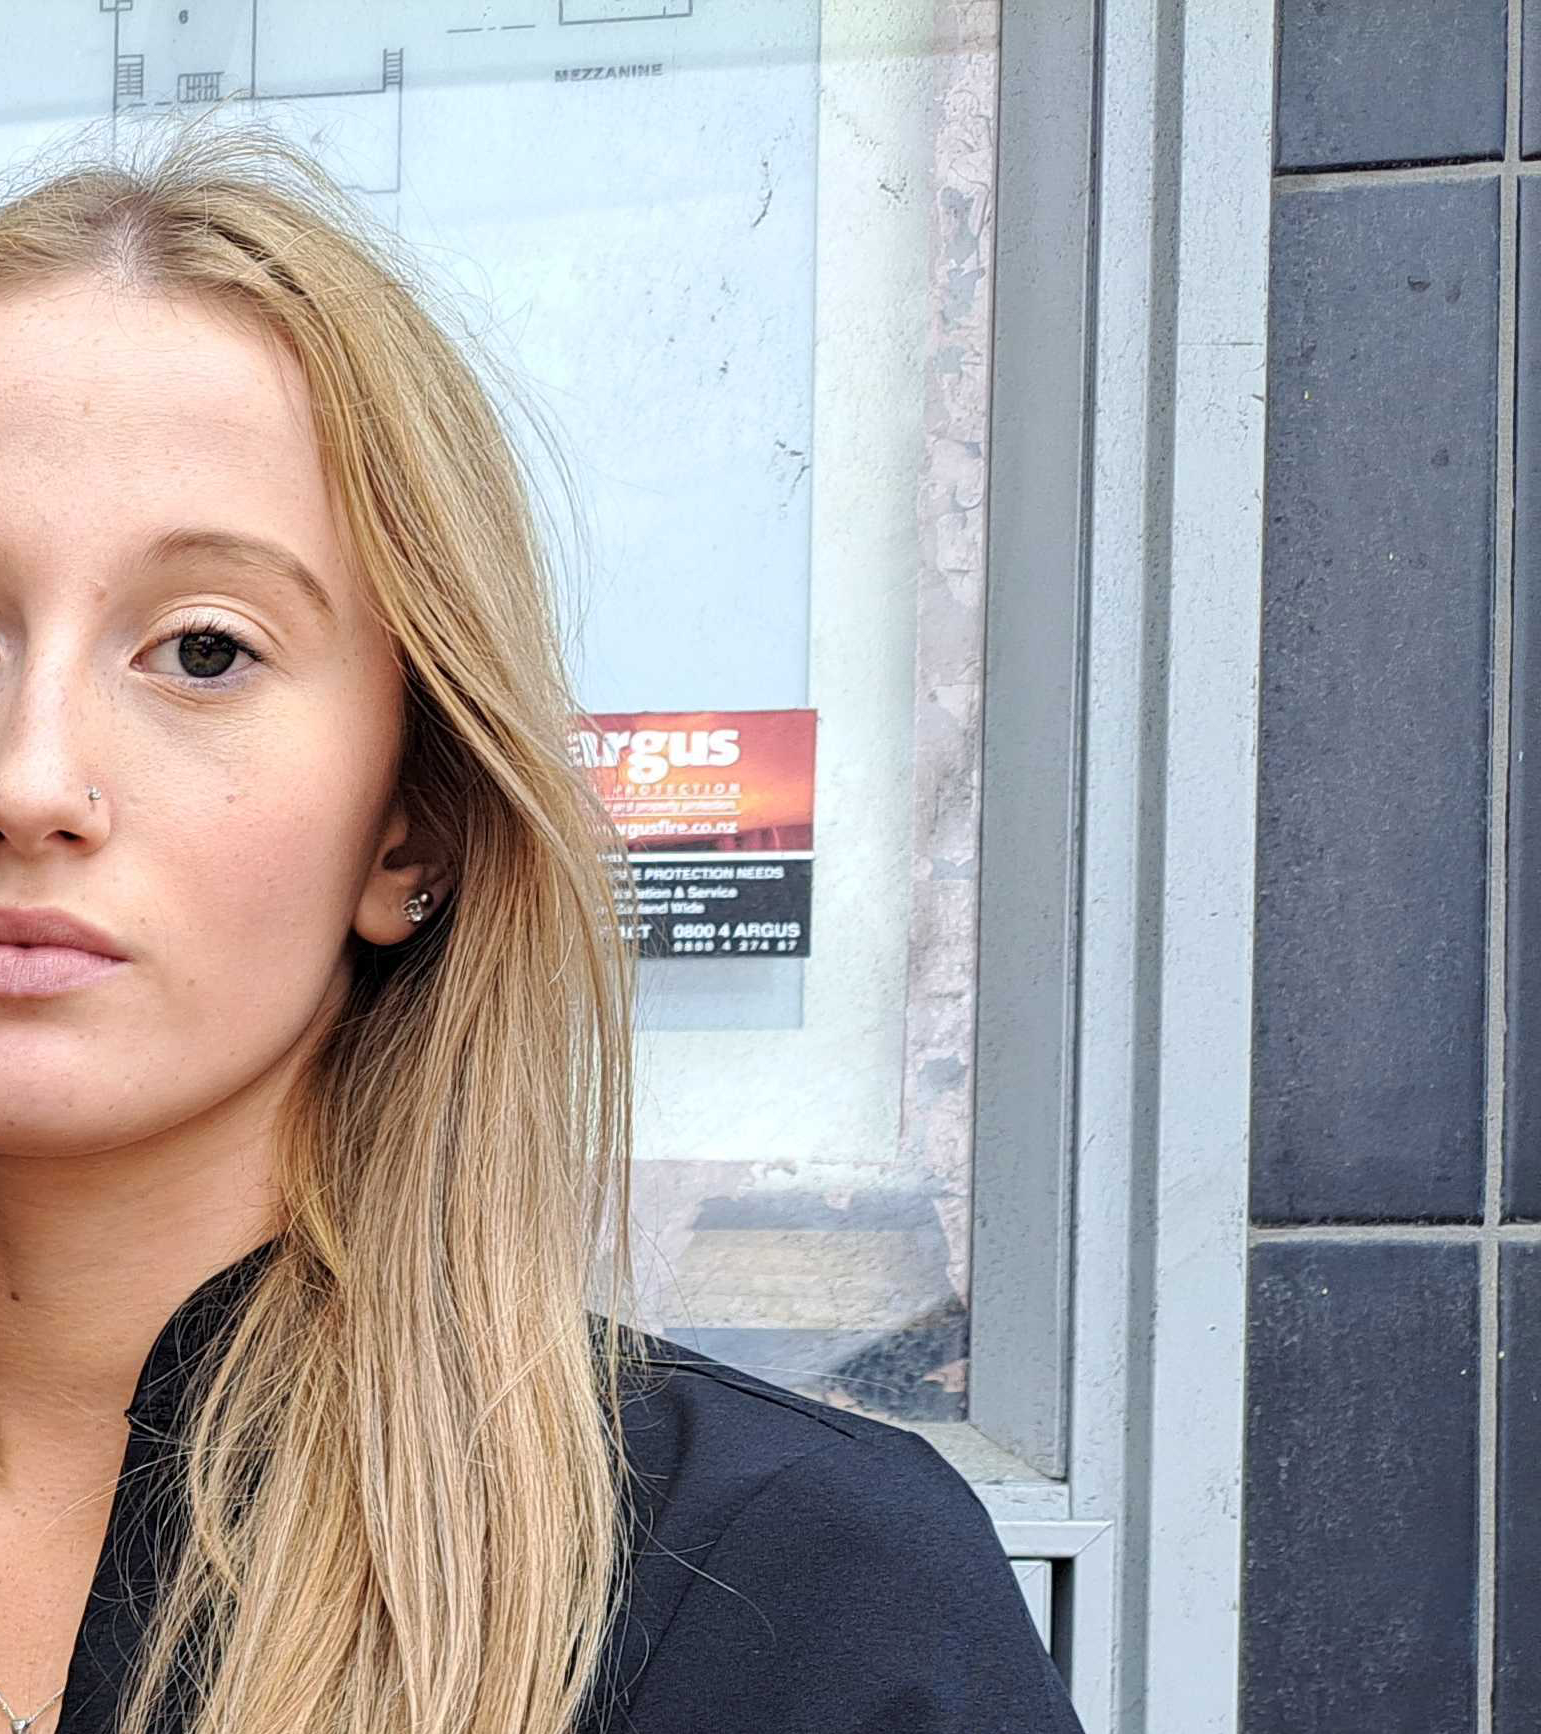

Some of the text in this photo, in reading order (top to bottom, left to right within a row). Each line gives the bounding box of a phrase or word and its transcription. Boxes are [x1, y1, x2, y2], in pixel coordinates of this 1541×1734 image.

[178, 9, 189, 24] 6
[554, 63, 663, 82] MEZZANINE
[644, 866, 734, 880] PROTECTION
[736, 865, 785, 879] NEEDS
[687, 885, 739, 899] Service
[672, 922, 716, 939] 0800
[717, 922, 731, 938] 4
[733, 921, 801, 938] ARGUS
[721, 940, 732, 951] 4
